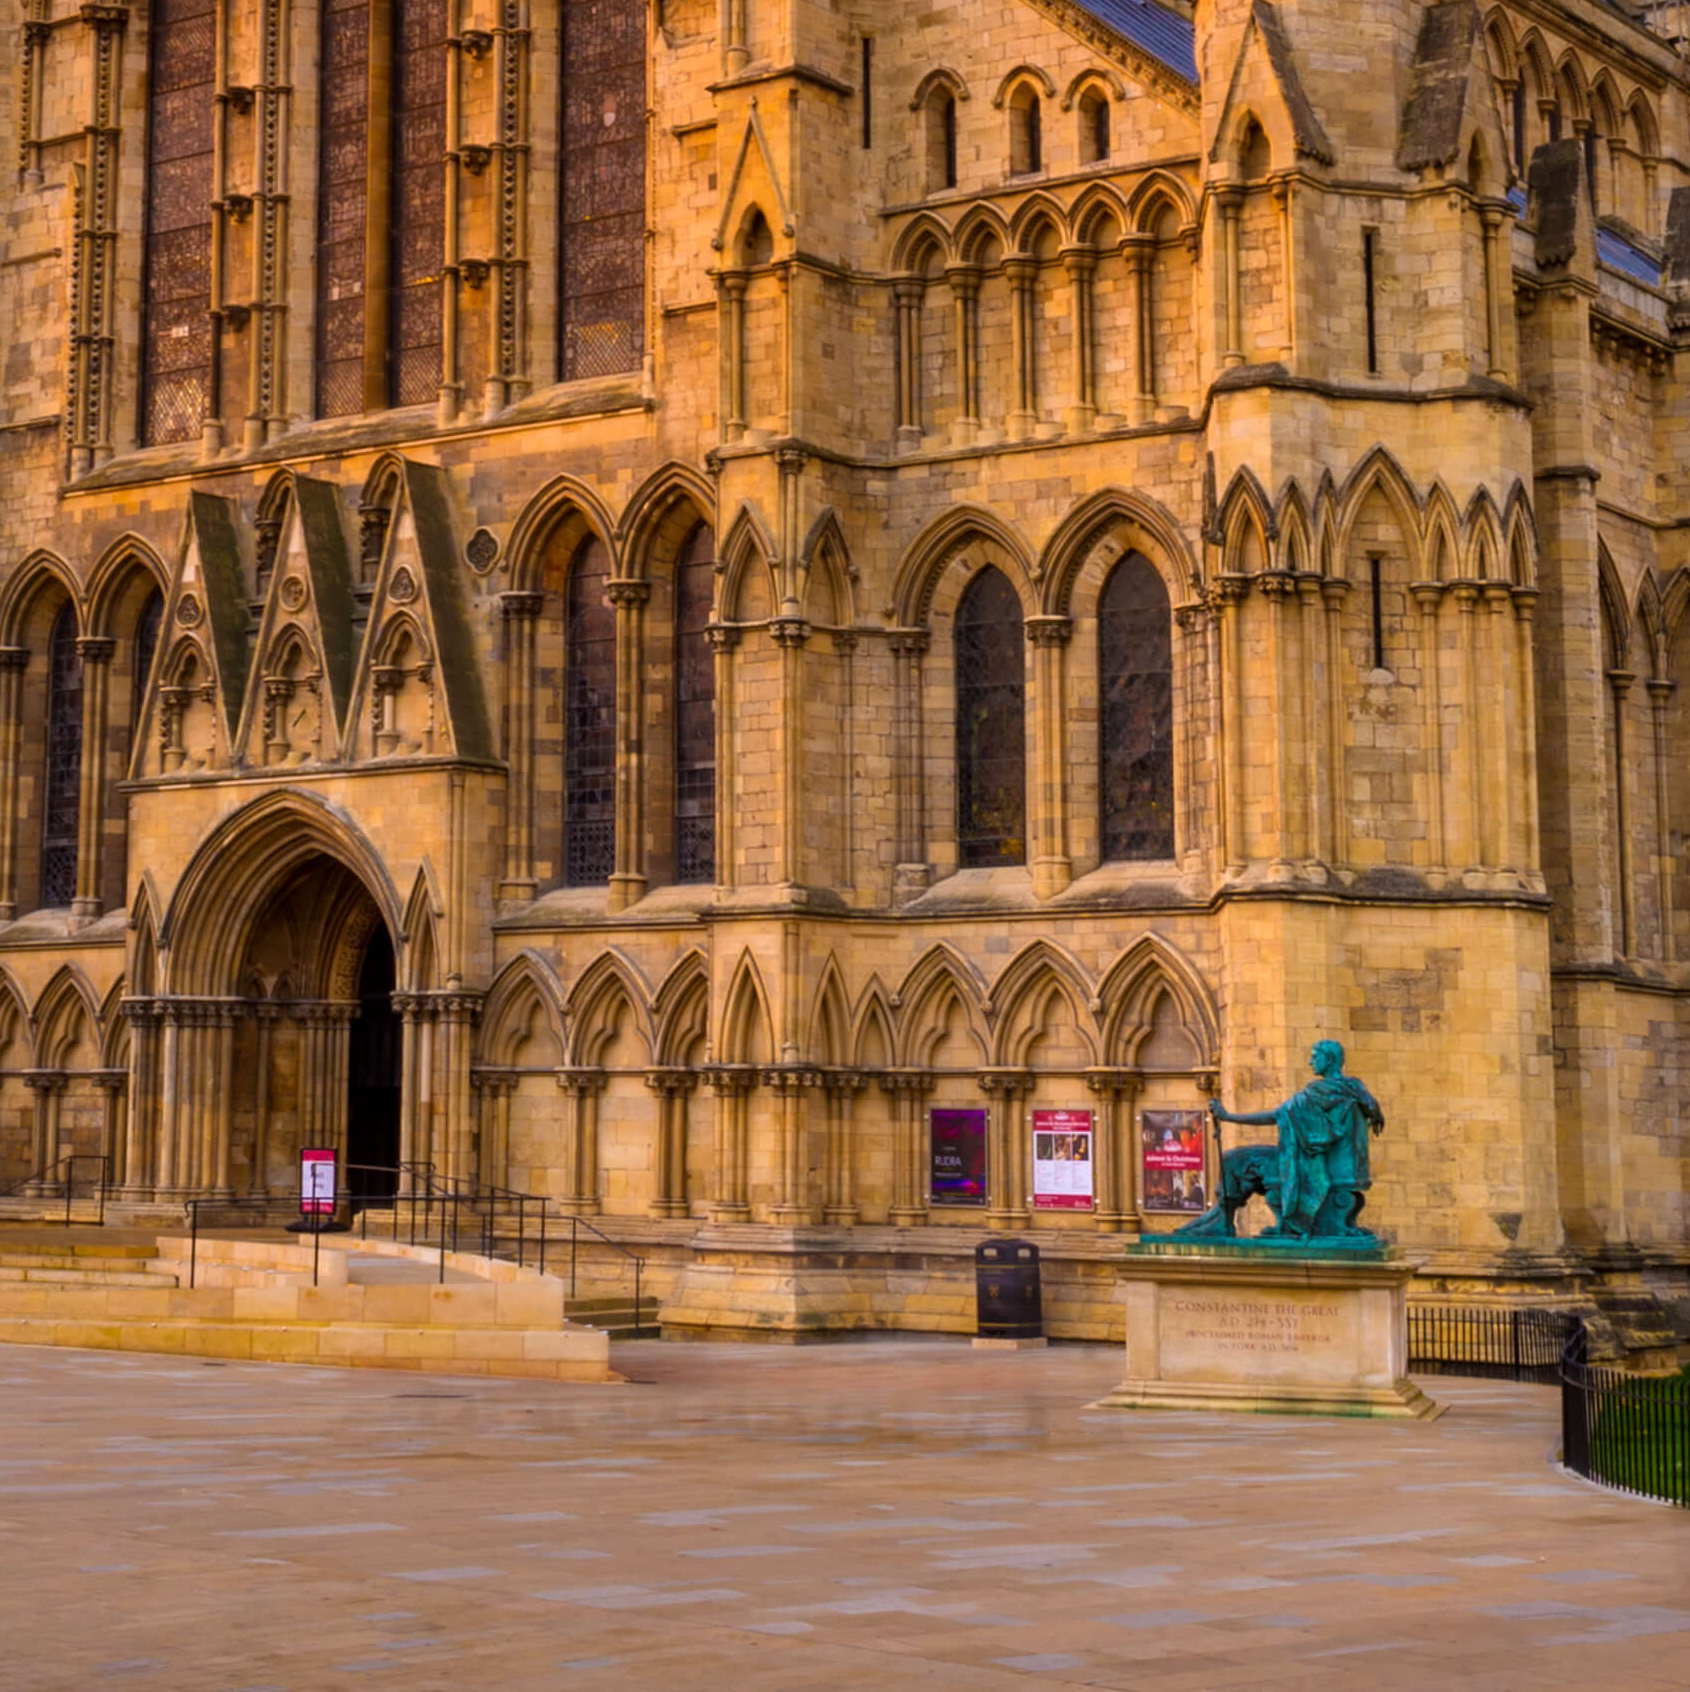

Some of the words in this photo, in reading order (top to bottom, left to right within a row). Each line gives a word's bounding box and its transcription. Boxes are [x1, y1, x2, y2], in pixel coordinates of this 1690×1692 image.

[1175, 1300, 1270, 1315] CONSTANTINE
[1275, 1303, 1296, 1315] THE
[1301, 1305, 1339, 1317] GREAT
[1248, 1331, 1284, 1341] ROMAN
